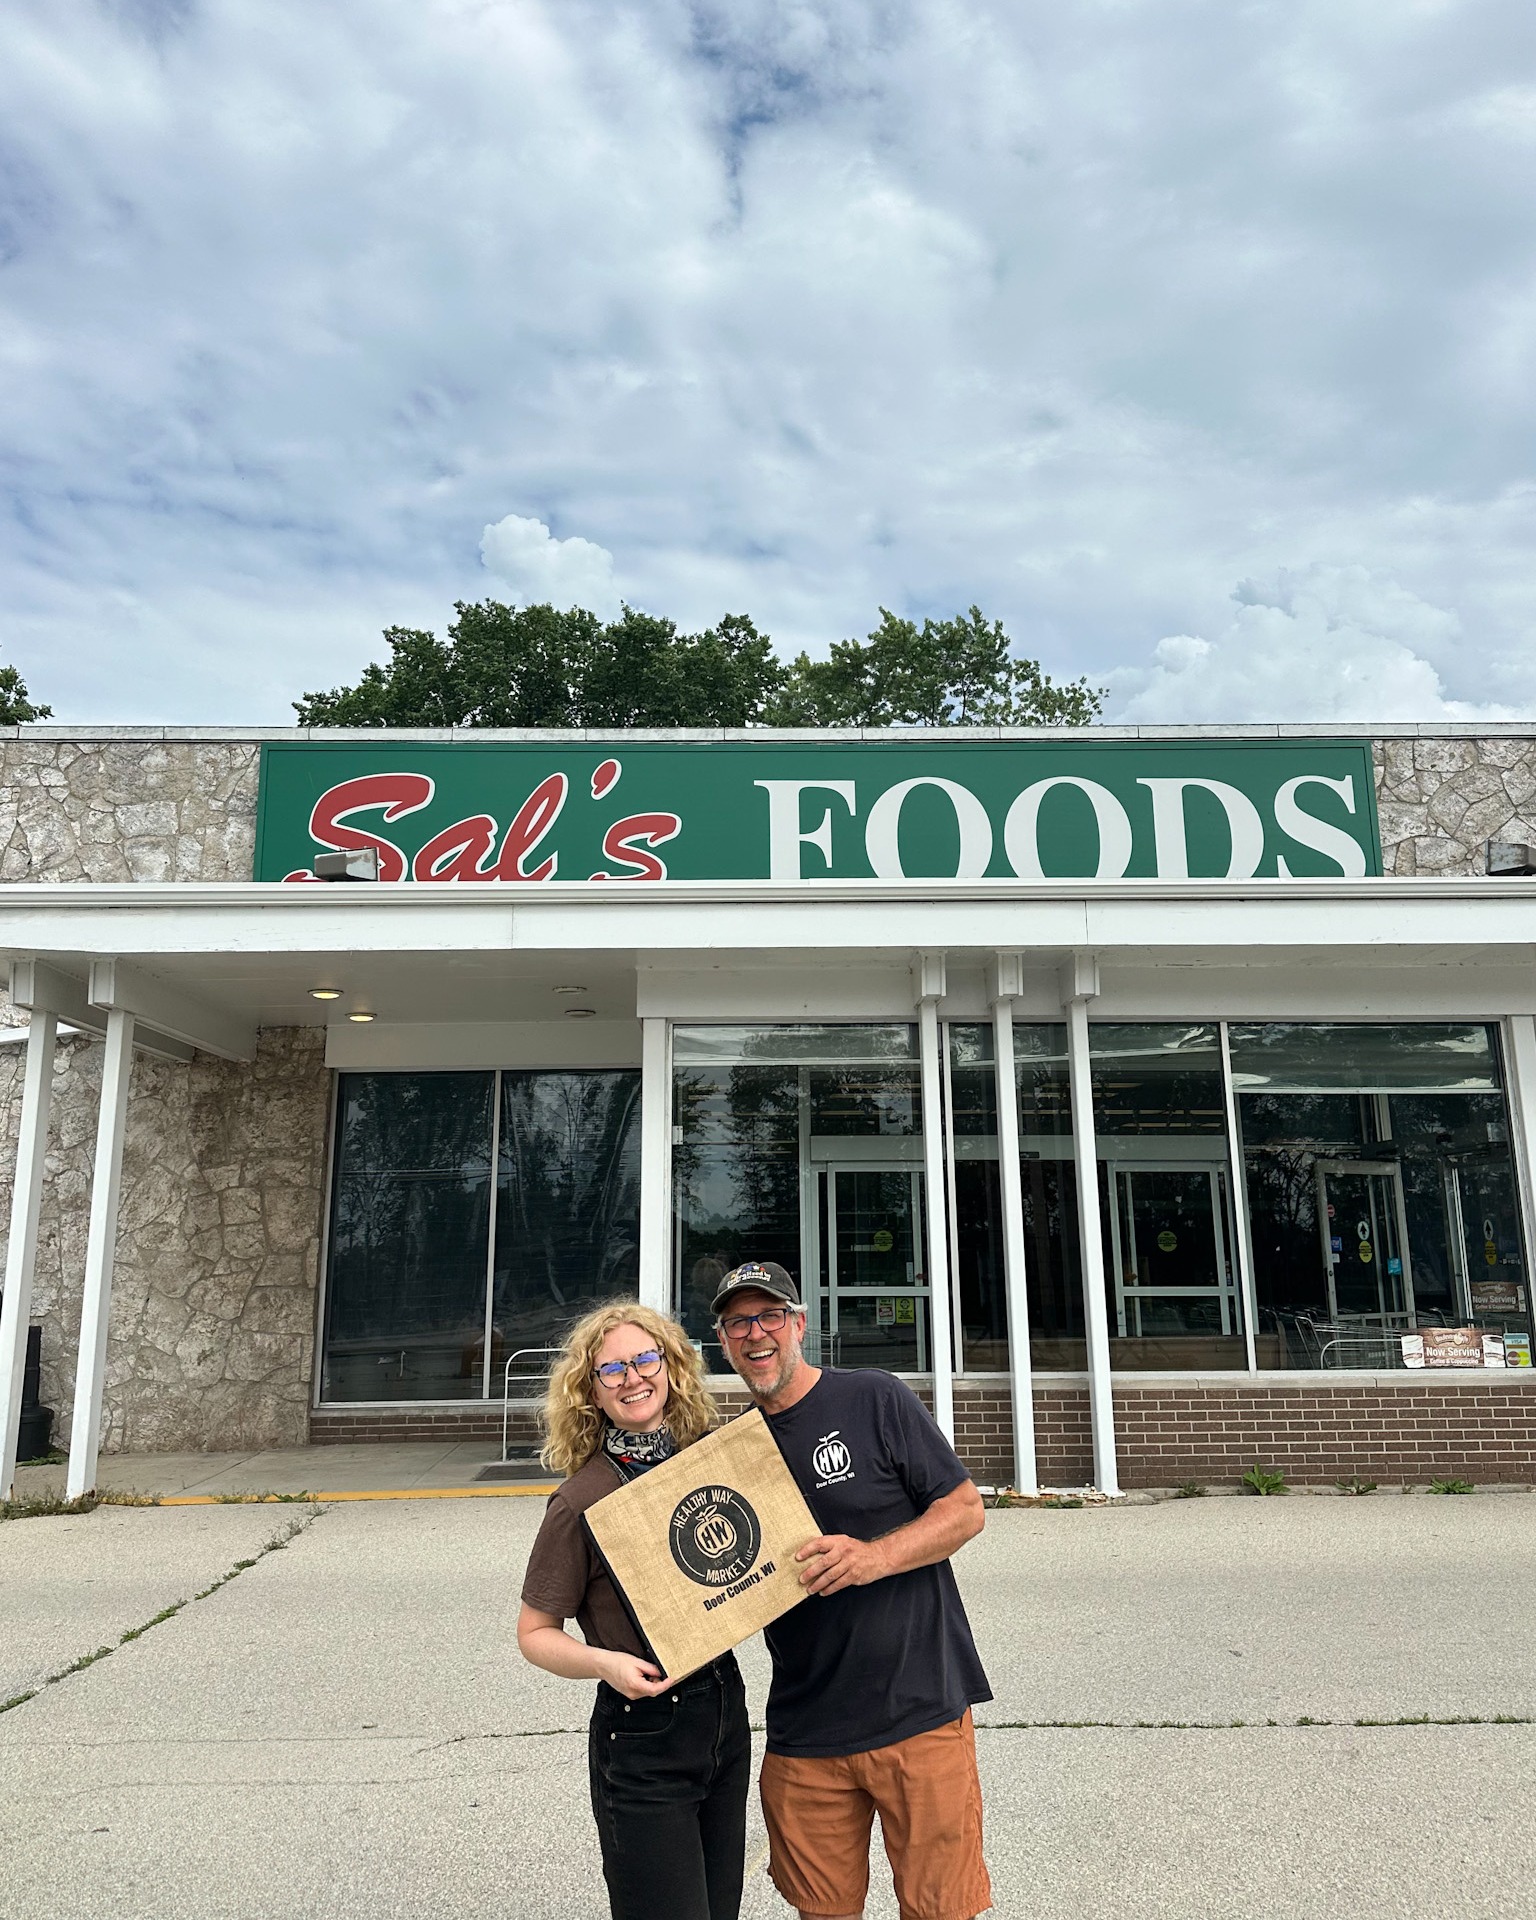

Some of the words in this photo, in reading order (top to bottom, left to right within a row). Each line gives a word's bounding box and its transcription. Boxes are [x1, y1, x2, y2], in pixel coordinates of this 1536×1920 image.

[283, 759, 681, 881] Sal's
[754, 775, 1367, 880] FOODS
[1490, 1295, 1516, 1305] Serving
[1426, 1347, 1445, 1357] Now
[1447, 1347, 1481, 1358] Serving
[818, 1444, 844, 1473] HW
[673, 1491, 708, 1529] HEALTHY
[711, 1489, 733, 1505] WAY
[701, 1520, 729, 1549] HW
[703, 1592, 727, 1611] Door
